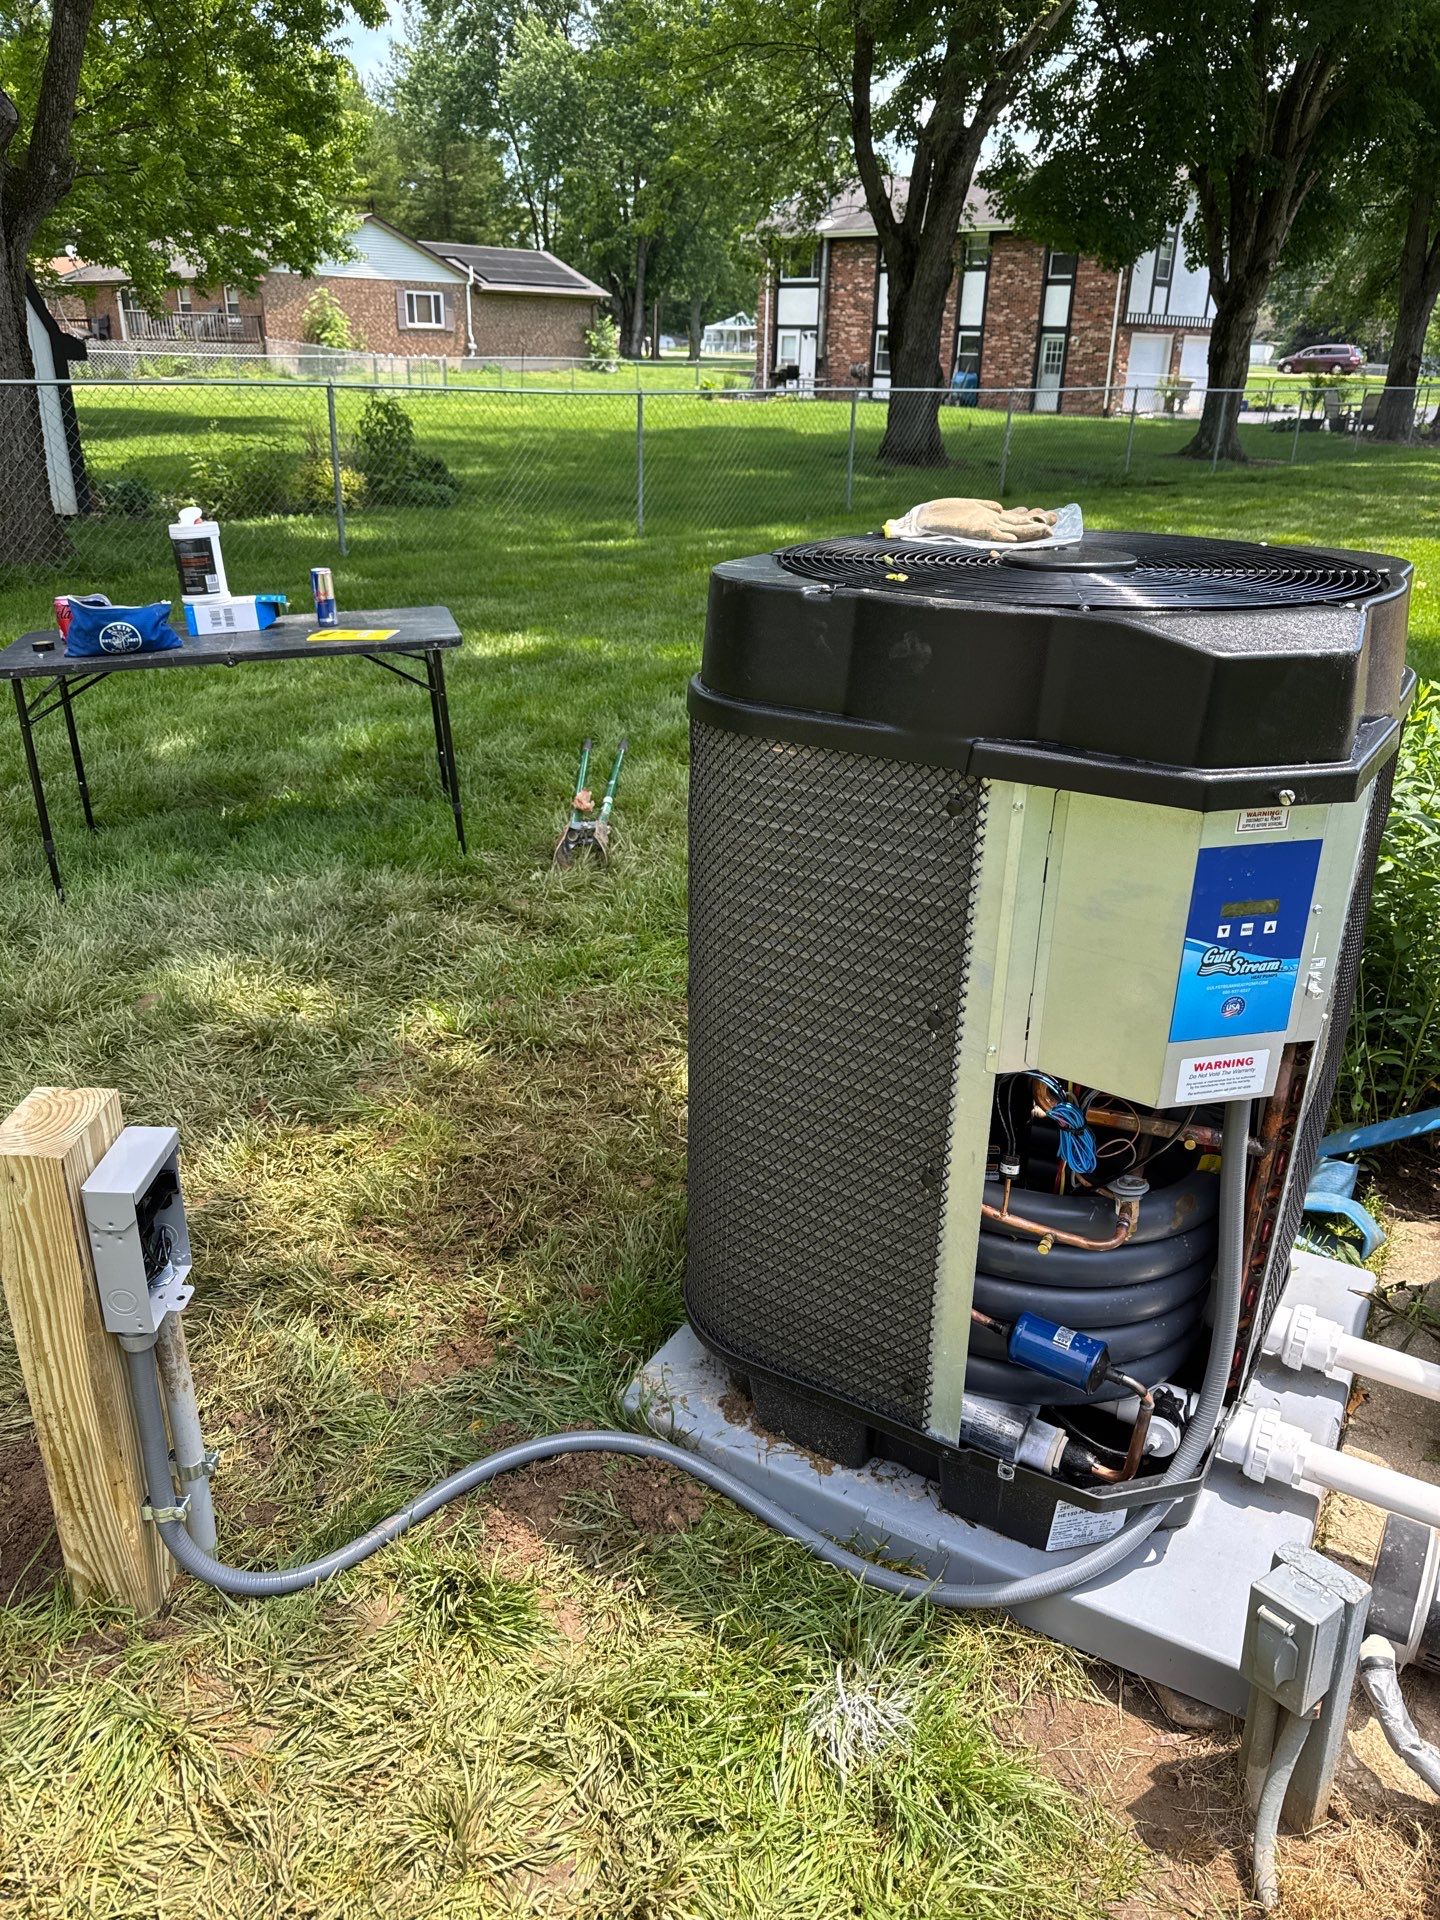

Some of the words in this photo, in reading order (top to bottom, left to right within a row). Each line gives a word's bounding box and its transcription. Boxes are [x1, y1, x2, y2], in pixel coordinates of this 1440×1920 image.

[106, 625, 131, 633] KLEIN
[1246, 809, 1283, 818] WARNING!
[1203, 947, 1237, 963] Gulf
[1229, 959, 1280, 974] Stream
[1194, 1057, 1254, 1072] WARNING
